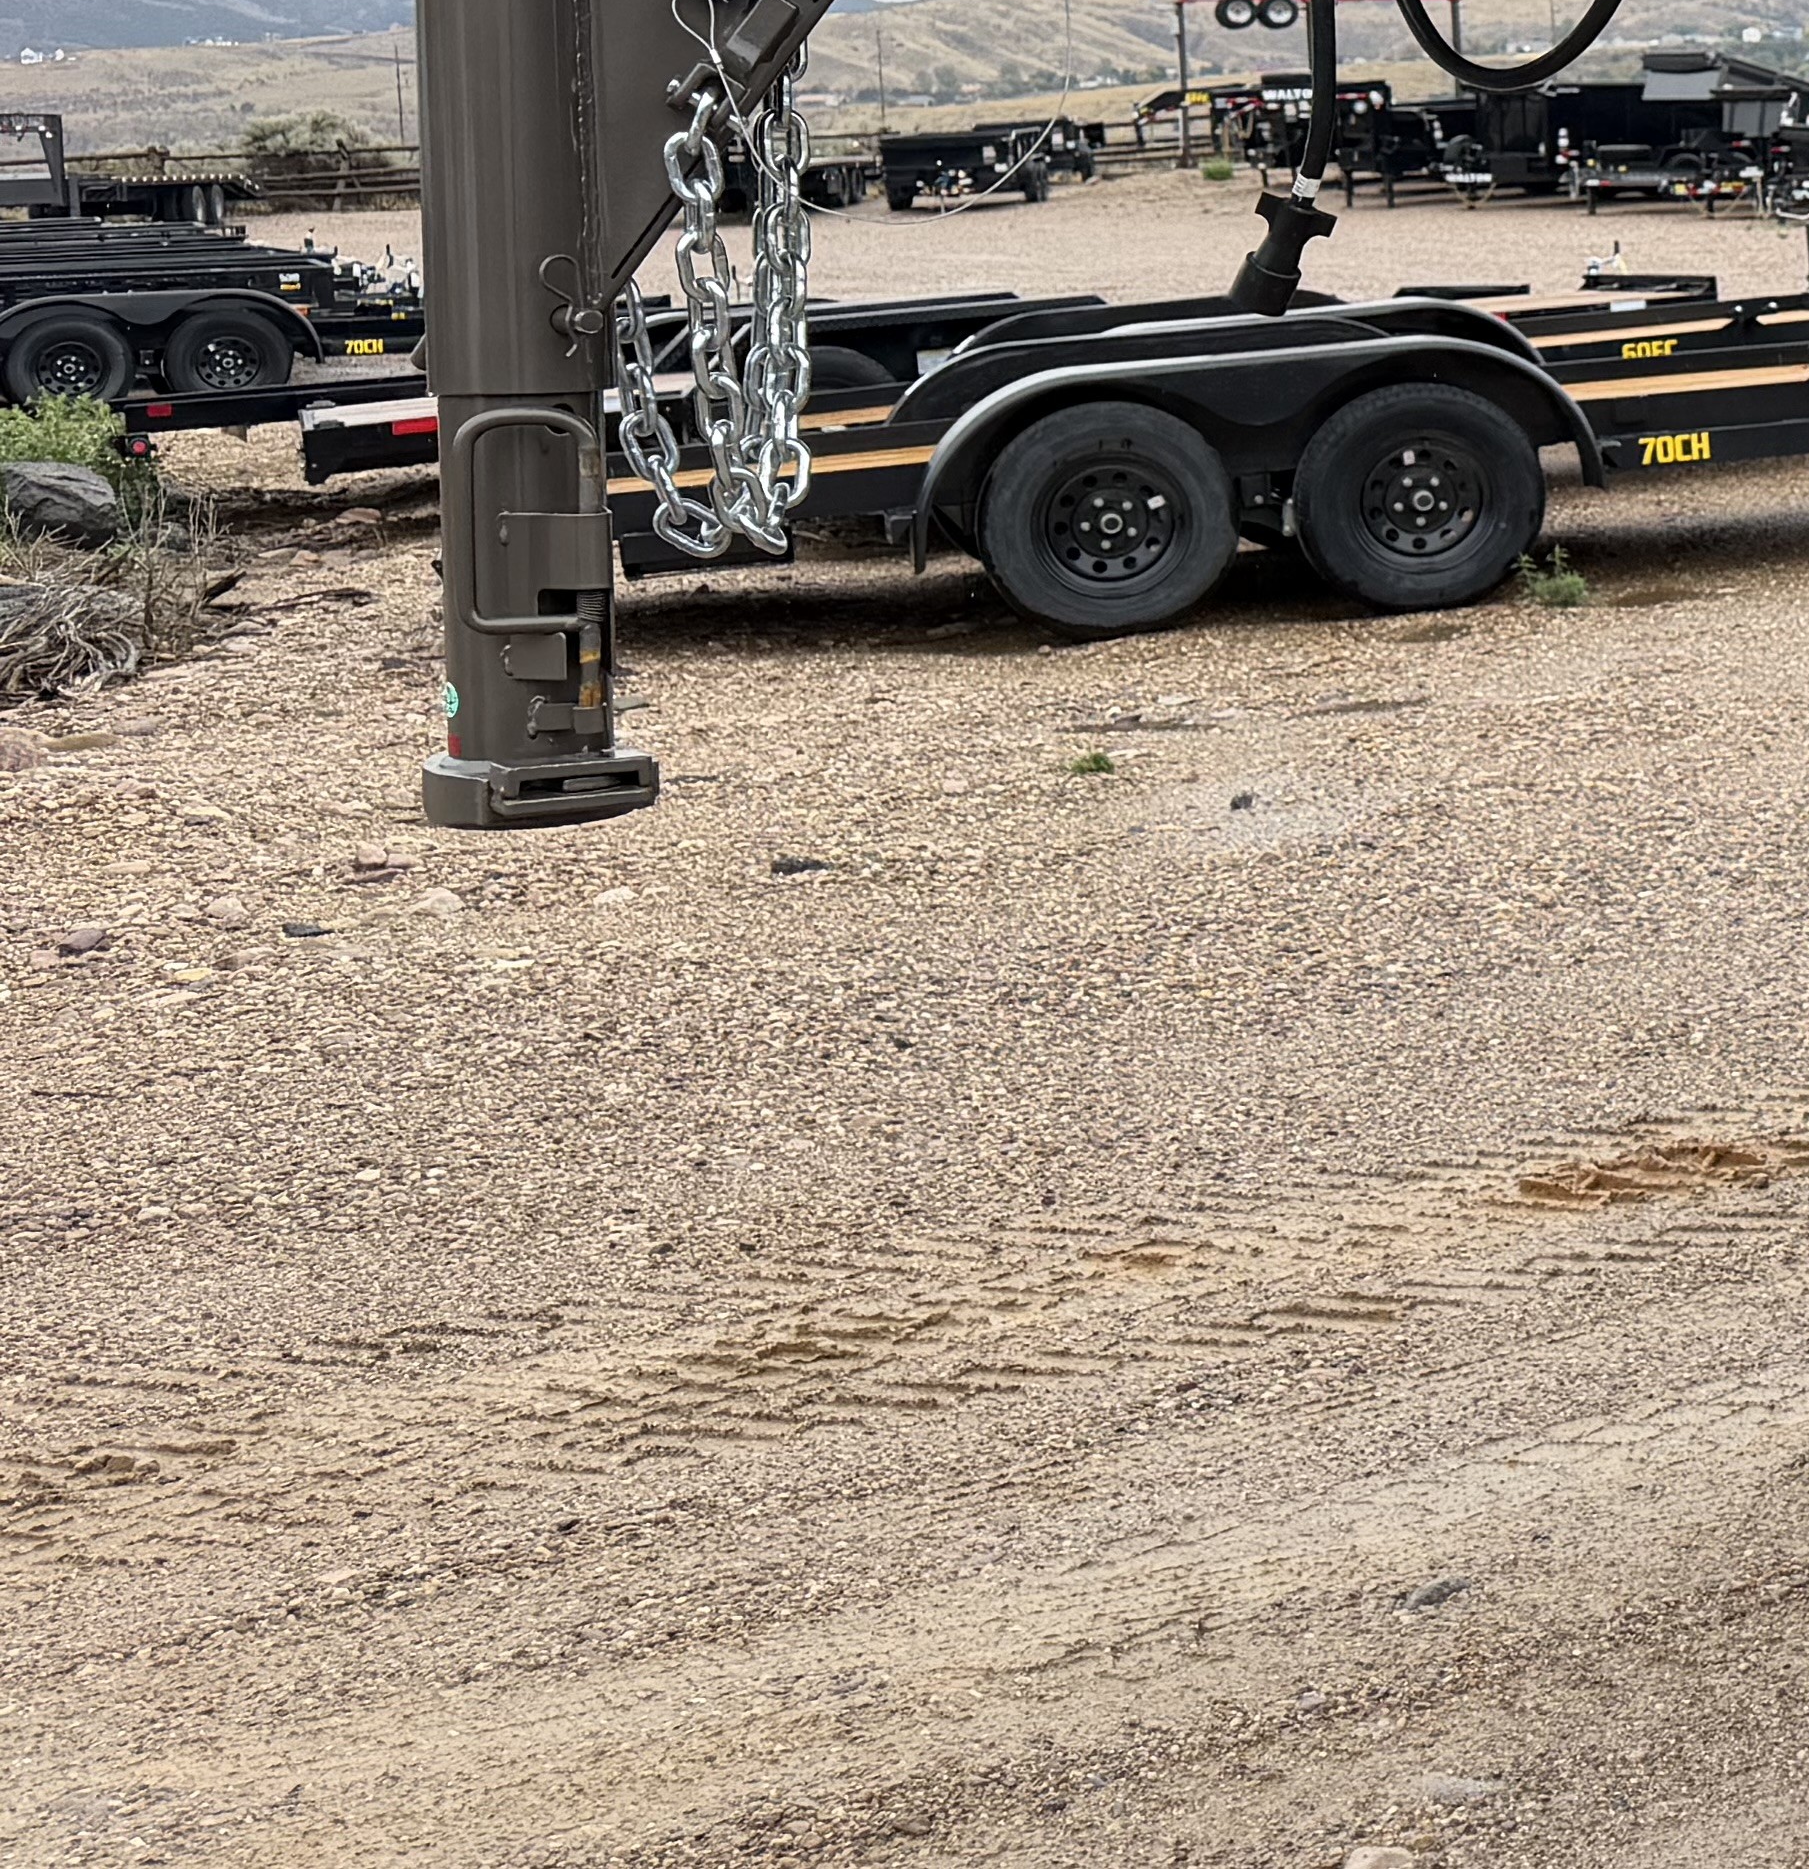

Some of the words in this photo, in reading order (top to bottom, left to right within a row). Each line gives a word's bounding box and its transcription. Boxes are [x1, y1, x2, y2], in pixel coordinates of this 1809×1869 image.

[1262, 88, 1313, 101] WALTO
[344, 338, 385, 355] 70CH
[1637, 431, 1712, 465] 70CH
